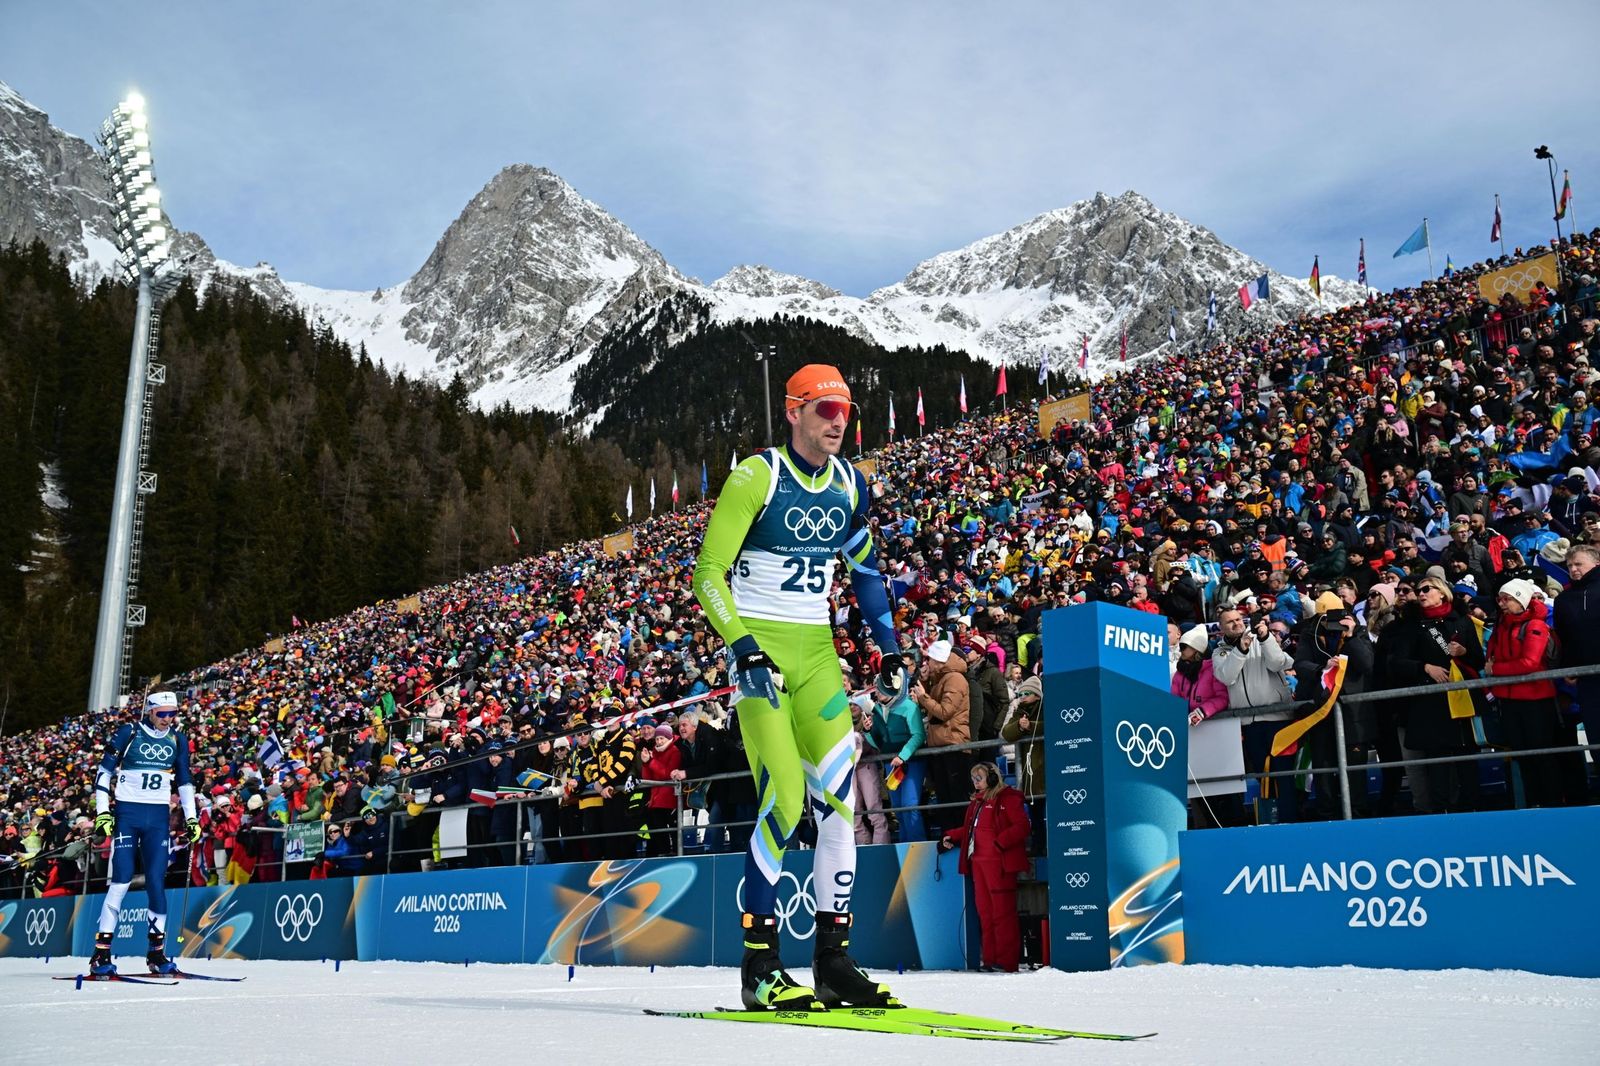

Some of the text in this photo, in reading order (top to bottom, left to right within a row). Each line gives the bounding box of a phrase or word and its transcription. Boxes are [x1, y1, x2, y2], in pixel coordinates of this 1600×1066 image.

[771, 545, 804, 553] MILANO
[733, 560, 751, 578] 5
[780, 556, 827, 594] 25
[700, 580, 733, 625] SLOVENIA
[1104, 624, 1164, 657] FINISH
[141, 772, 163, 790] 18
[1222, 853, 1577, 895] MILANO CORTINA
[394, 891, 508, 914] MILANO CORTINA
[833, 870, 854, 914] SLO
[1347, 896, 1429, 928] 2026
[117, 924, 135, 939] 2026
[433, 914, 461, 933] 2026
[775, 1011, 809, 1020] FISCHER
[851, 1009, 886, 1017] FISCHER
